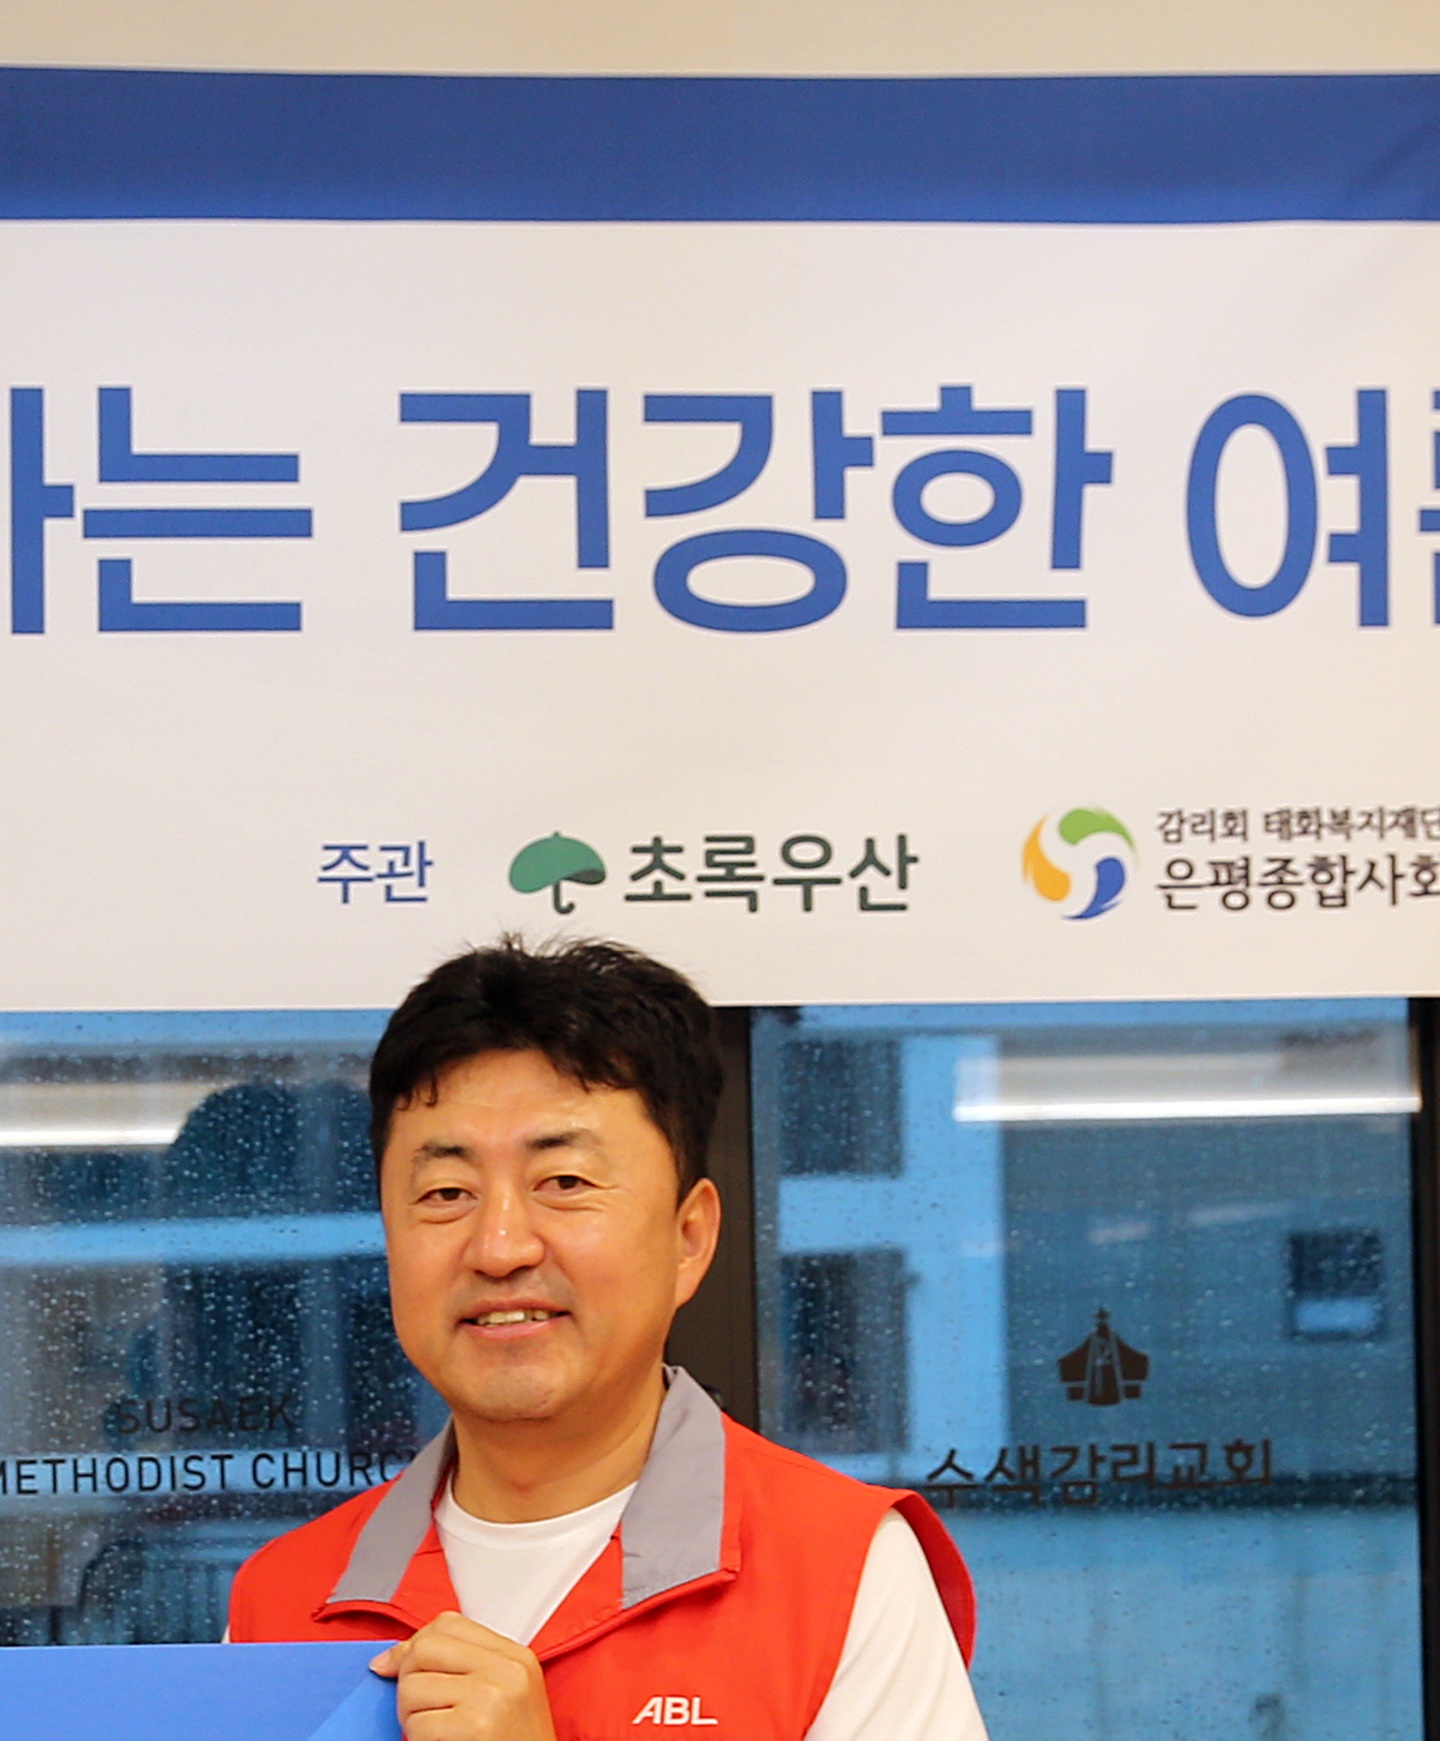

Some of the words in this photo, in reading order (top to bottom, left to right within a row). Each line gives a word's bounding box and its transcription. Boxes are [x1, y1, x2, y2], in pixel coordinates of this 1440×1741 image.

[399, 386, 1113, 633] 건강한
[1158, 809, 1248, 844] 감리회
[318, 841, 433, 904] 주관
[624, 834, 919, 913] 초록우산
[114, 1394, 297, 1436] SUSAEK
[252, 1449, 417, 1490] CHURC
[925, 1439, 1272, 1510] 수색감리교회
[633, 1697, 718, 1724] ABL
